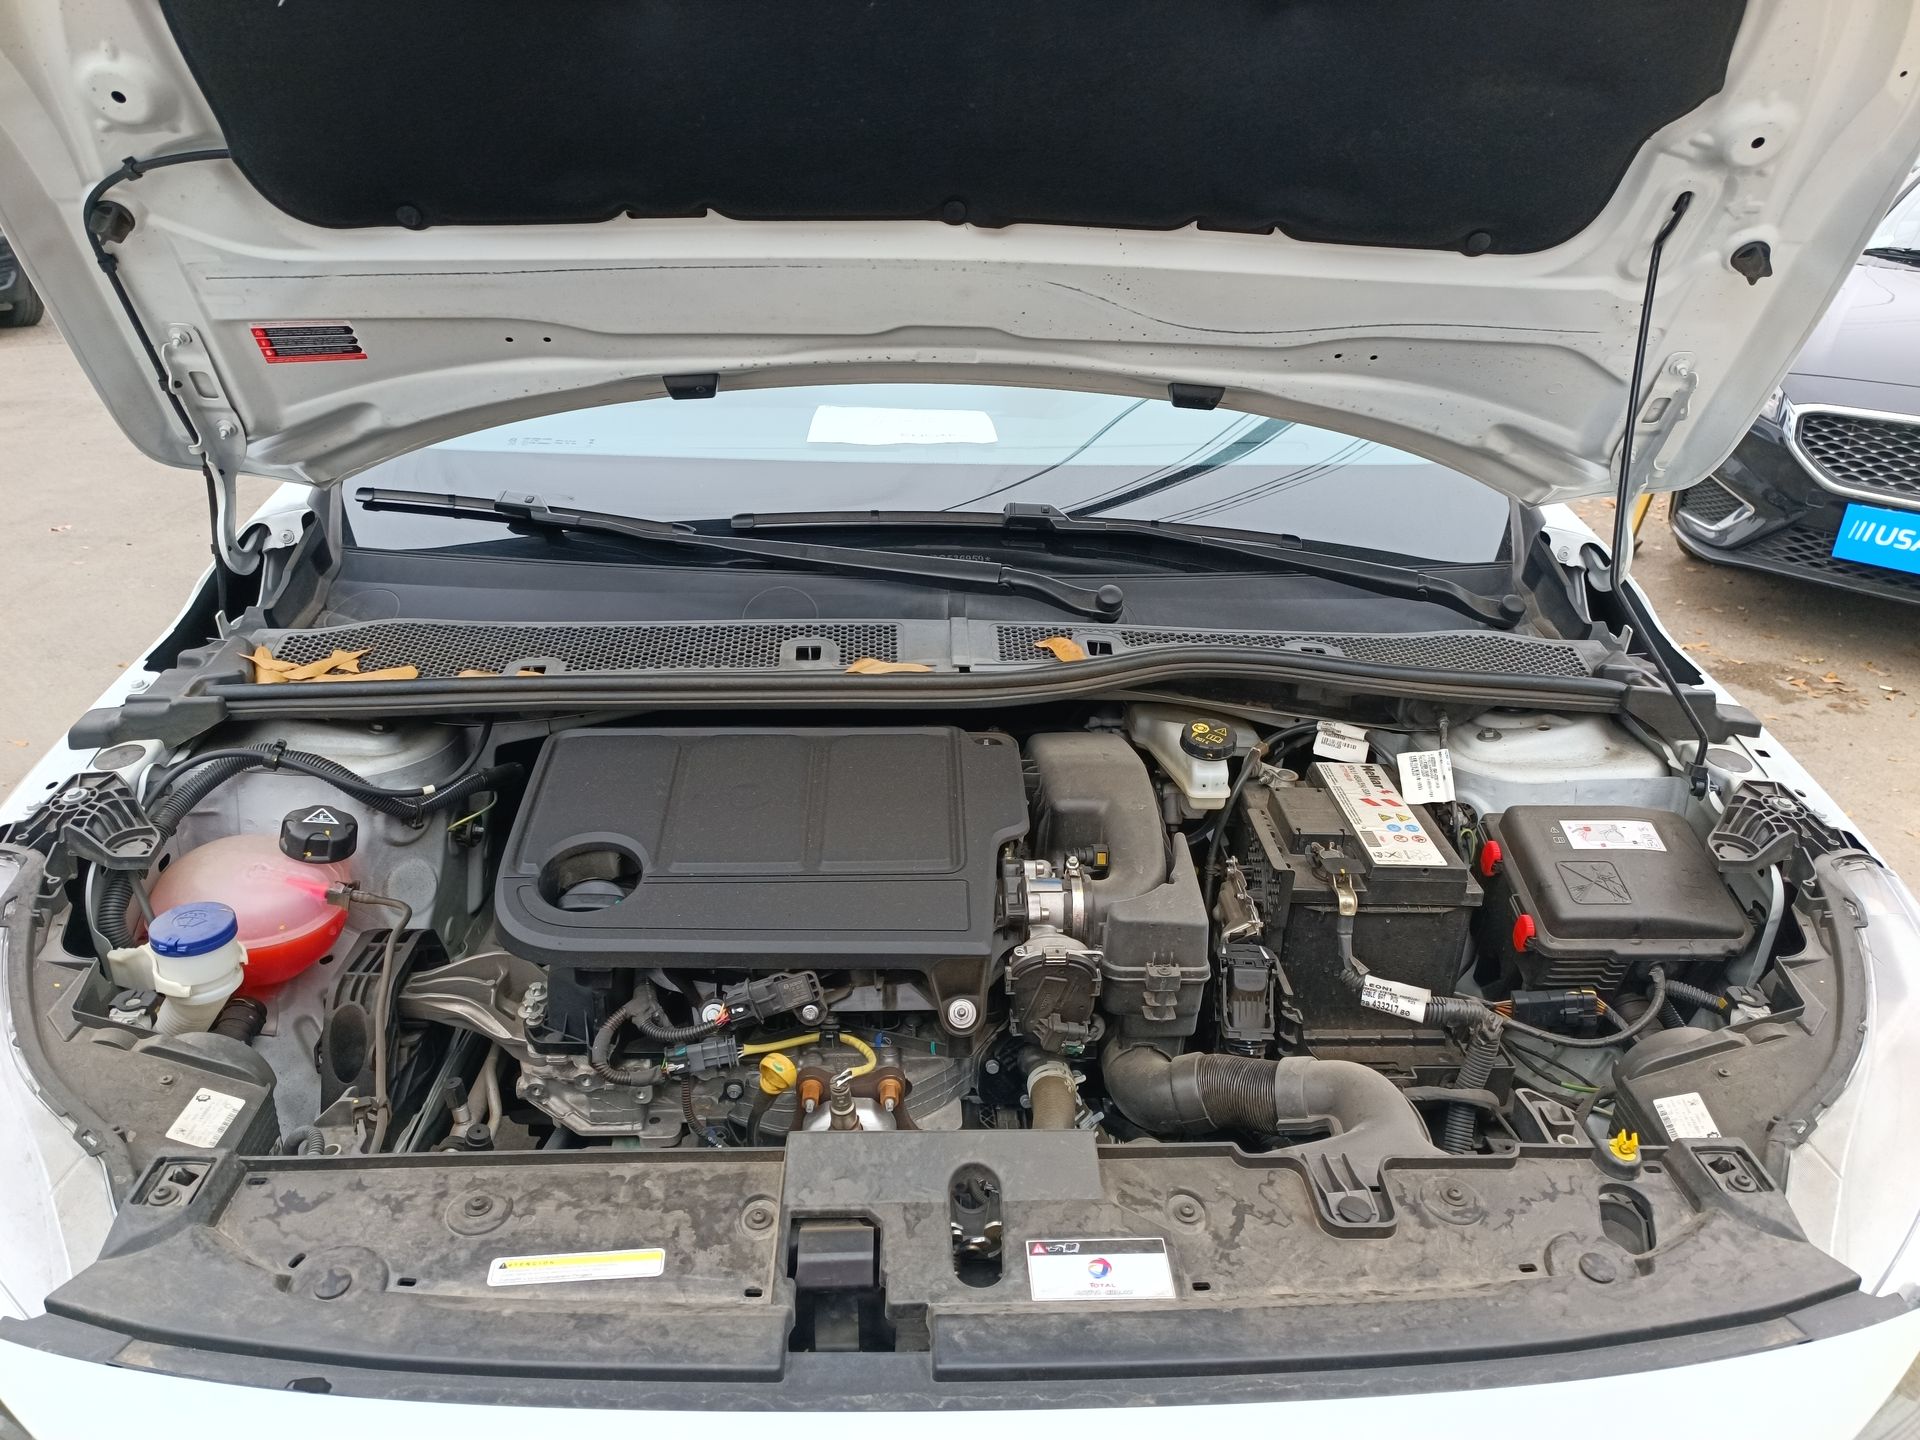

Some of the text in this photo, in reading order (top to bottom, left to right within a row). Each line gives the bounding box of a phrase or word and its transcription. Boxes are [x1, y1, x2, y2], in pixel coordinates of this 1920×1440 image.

[1360, 765, 1385, 789] Heliar
[1364, 983, 1392, 992] LEONI
[1372, 1000, 1399, 1014] 433217
